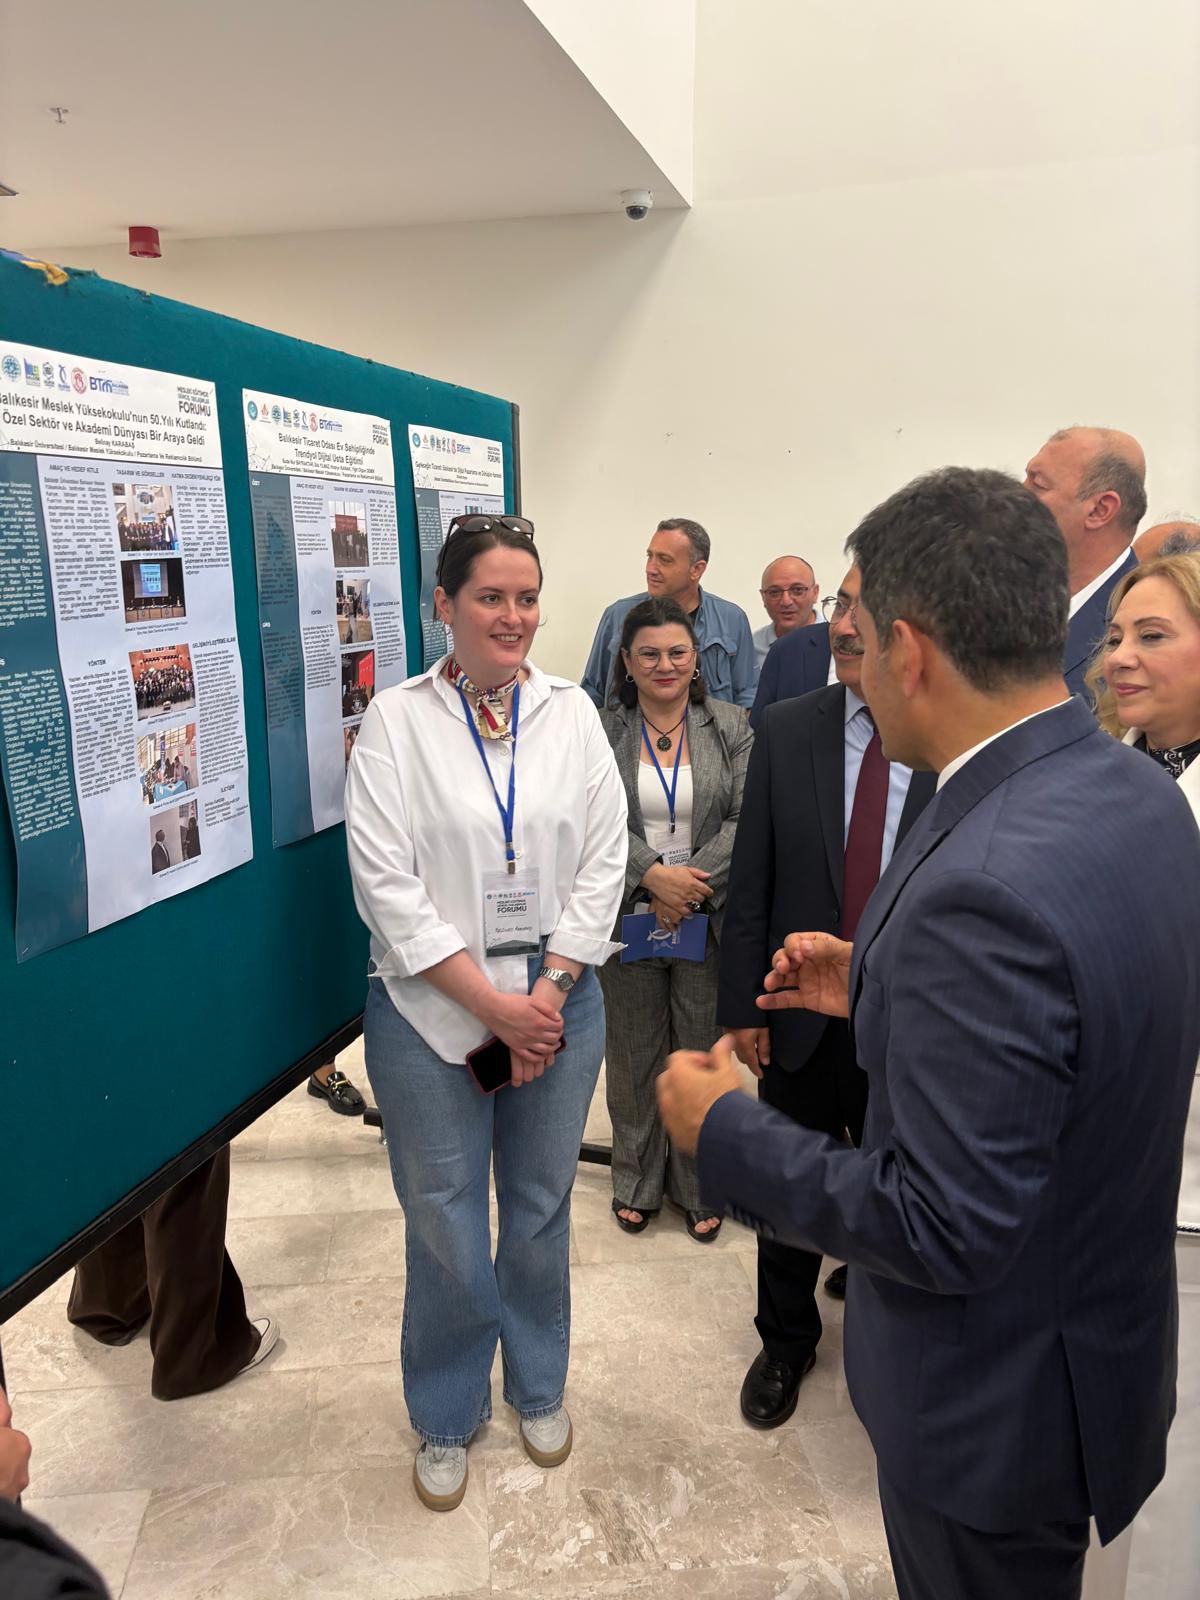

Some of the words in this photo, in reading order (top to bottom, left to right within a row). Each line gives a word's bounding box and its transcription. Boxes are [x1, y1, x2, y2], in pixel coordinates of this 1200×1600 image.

[42, 397, 74, 414] Meslek
[75, 403, 148, 424] Yüksekokulu'nun
[150, 414, 174, 427] 50.Yılı
[176, 418, 207, 431] Kutlandı:
[178, 401, 211, 416] FORUMU
[2, 408, 26, 426] Özel
[28, 414, 60, 430] Sektör
[62, 421, 73, 431] ve
[75, 420, 112, 436] Akademi
[114, 426, 148, 440] Dünyası
[150, 430, 162, 441] Bir
[163, 432, 185, 445] Araya
[186, 434, 205, 446] Geldi
[278, 432, 302, 445] Balıkesir
[302, 436, 320, 448] Ticaret
[321, 440, 336, 450] Odası
[336, 442, 344, 450] Ev
[345, 444, 375, 456] Sahipliğinde
[294, 448, 317, 460] Trendyol
[318, 452, 332, 462] Dijital
[332, 454, 344, 463] Usta
[345, 456, 363, 466] Eğitimi
